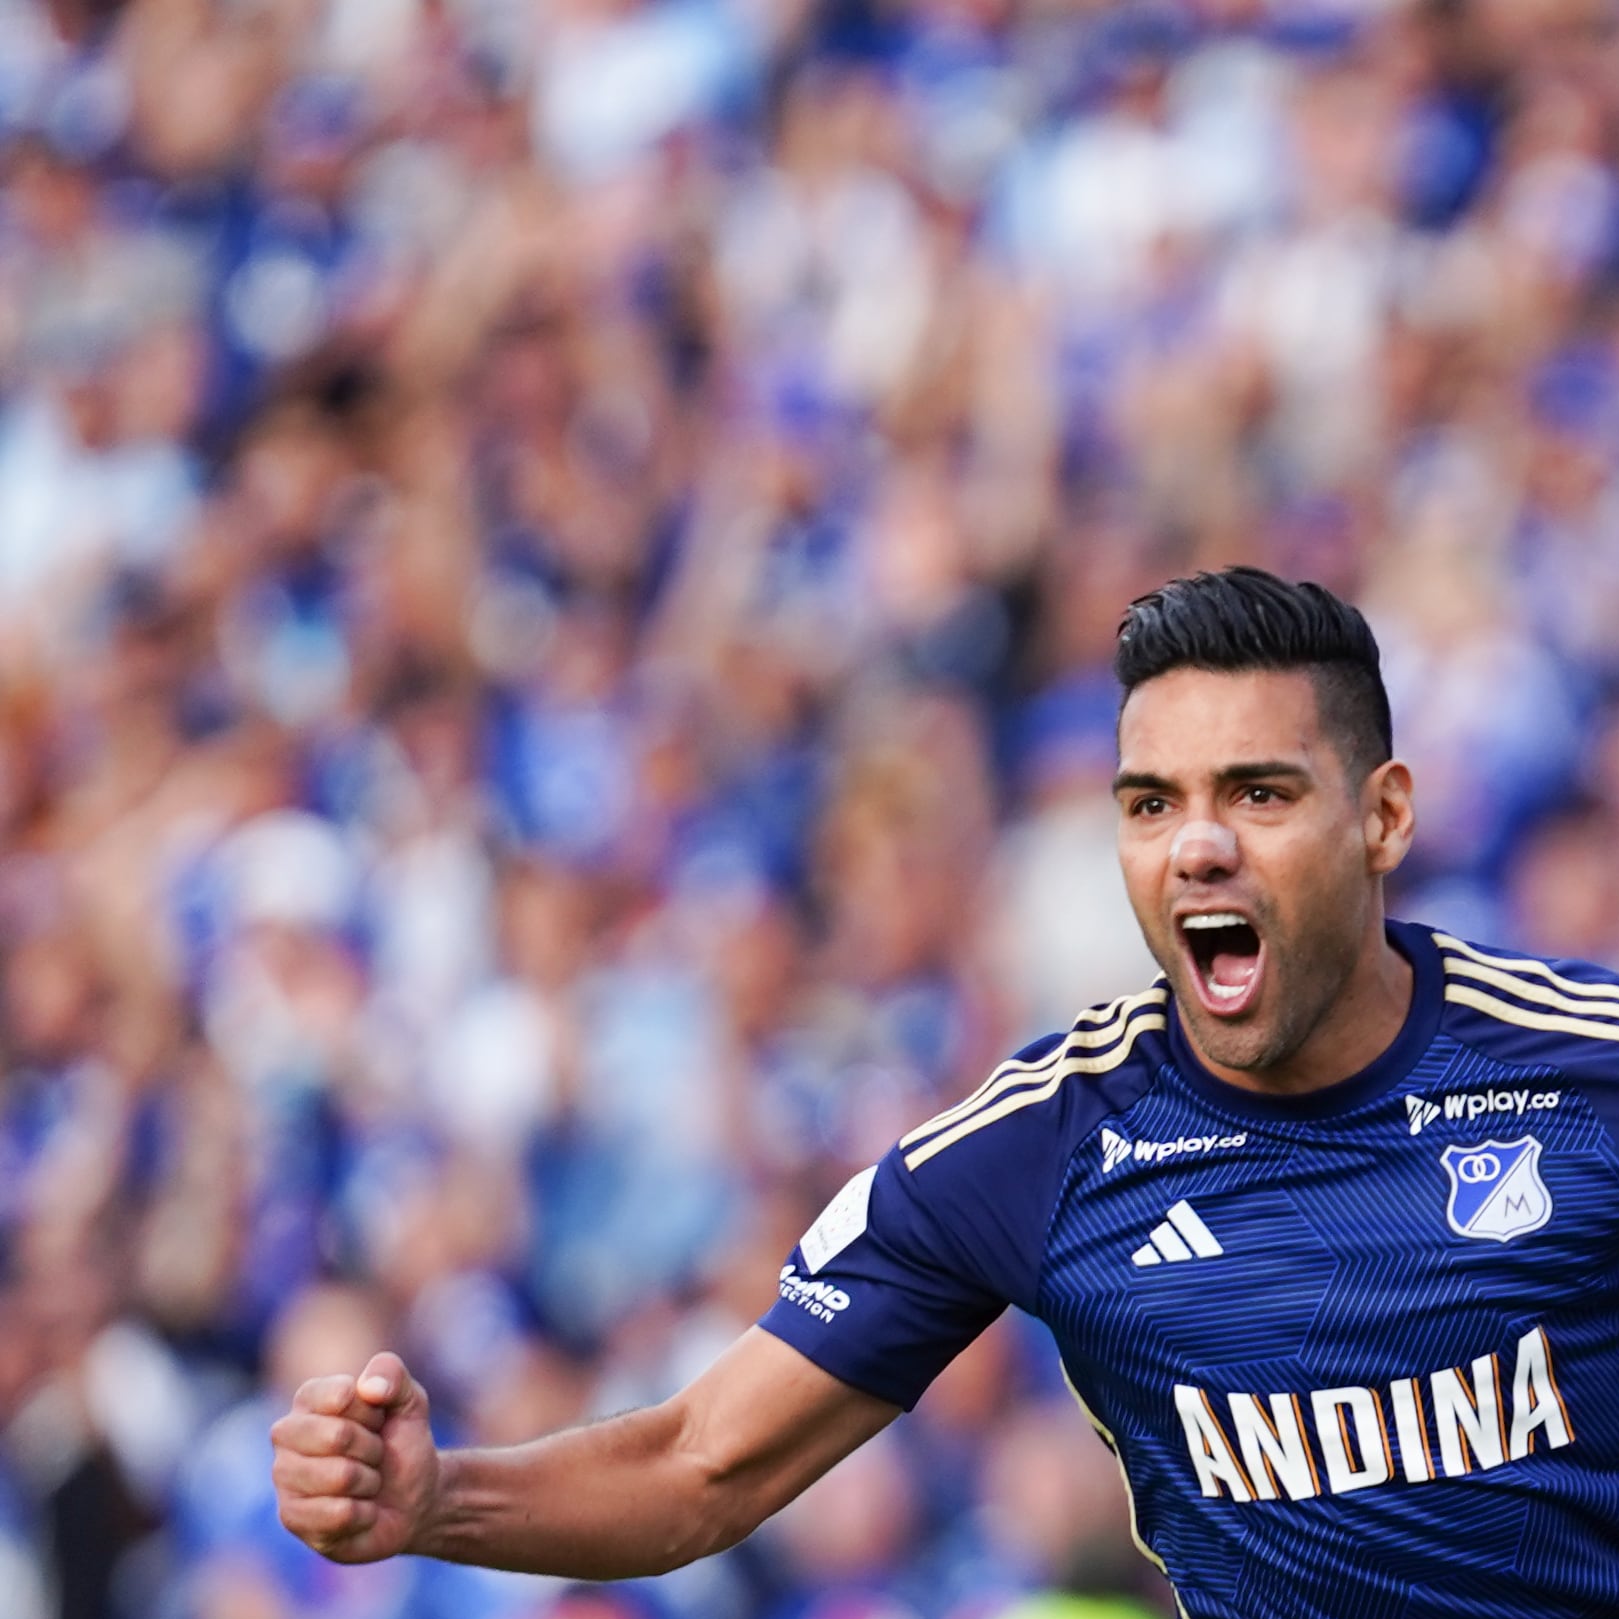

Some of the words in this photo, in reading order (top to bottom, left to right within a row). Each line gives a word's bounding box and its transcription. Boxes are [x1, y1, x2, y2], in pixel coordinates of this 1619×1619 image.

[1443, 1089, 1560, 1121] Wplay.co
[1133, 1132, 1248, 1162] Wplay.co
[1173, 1324, 1576, 1503] ANDINA
